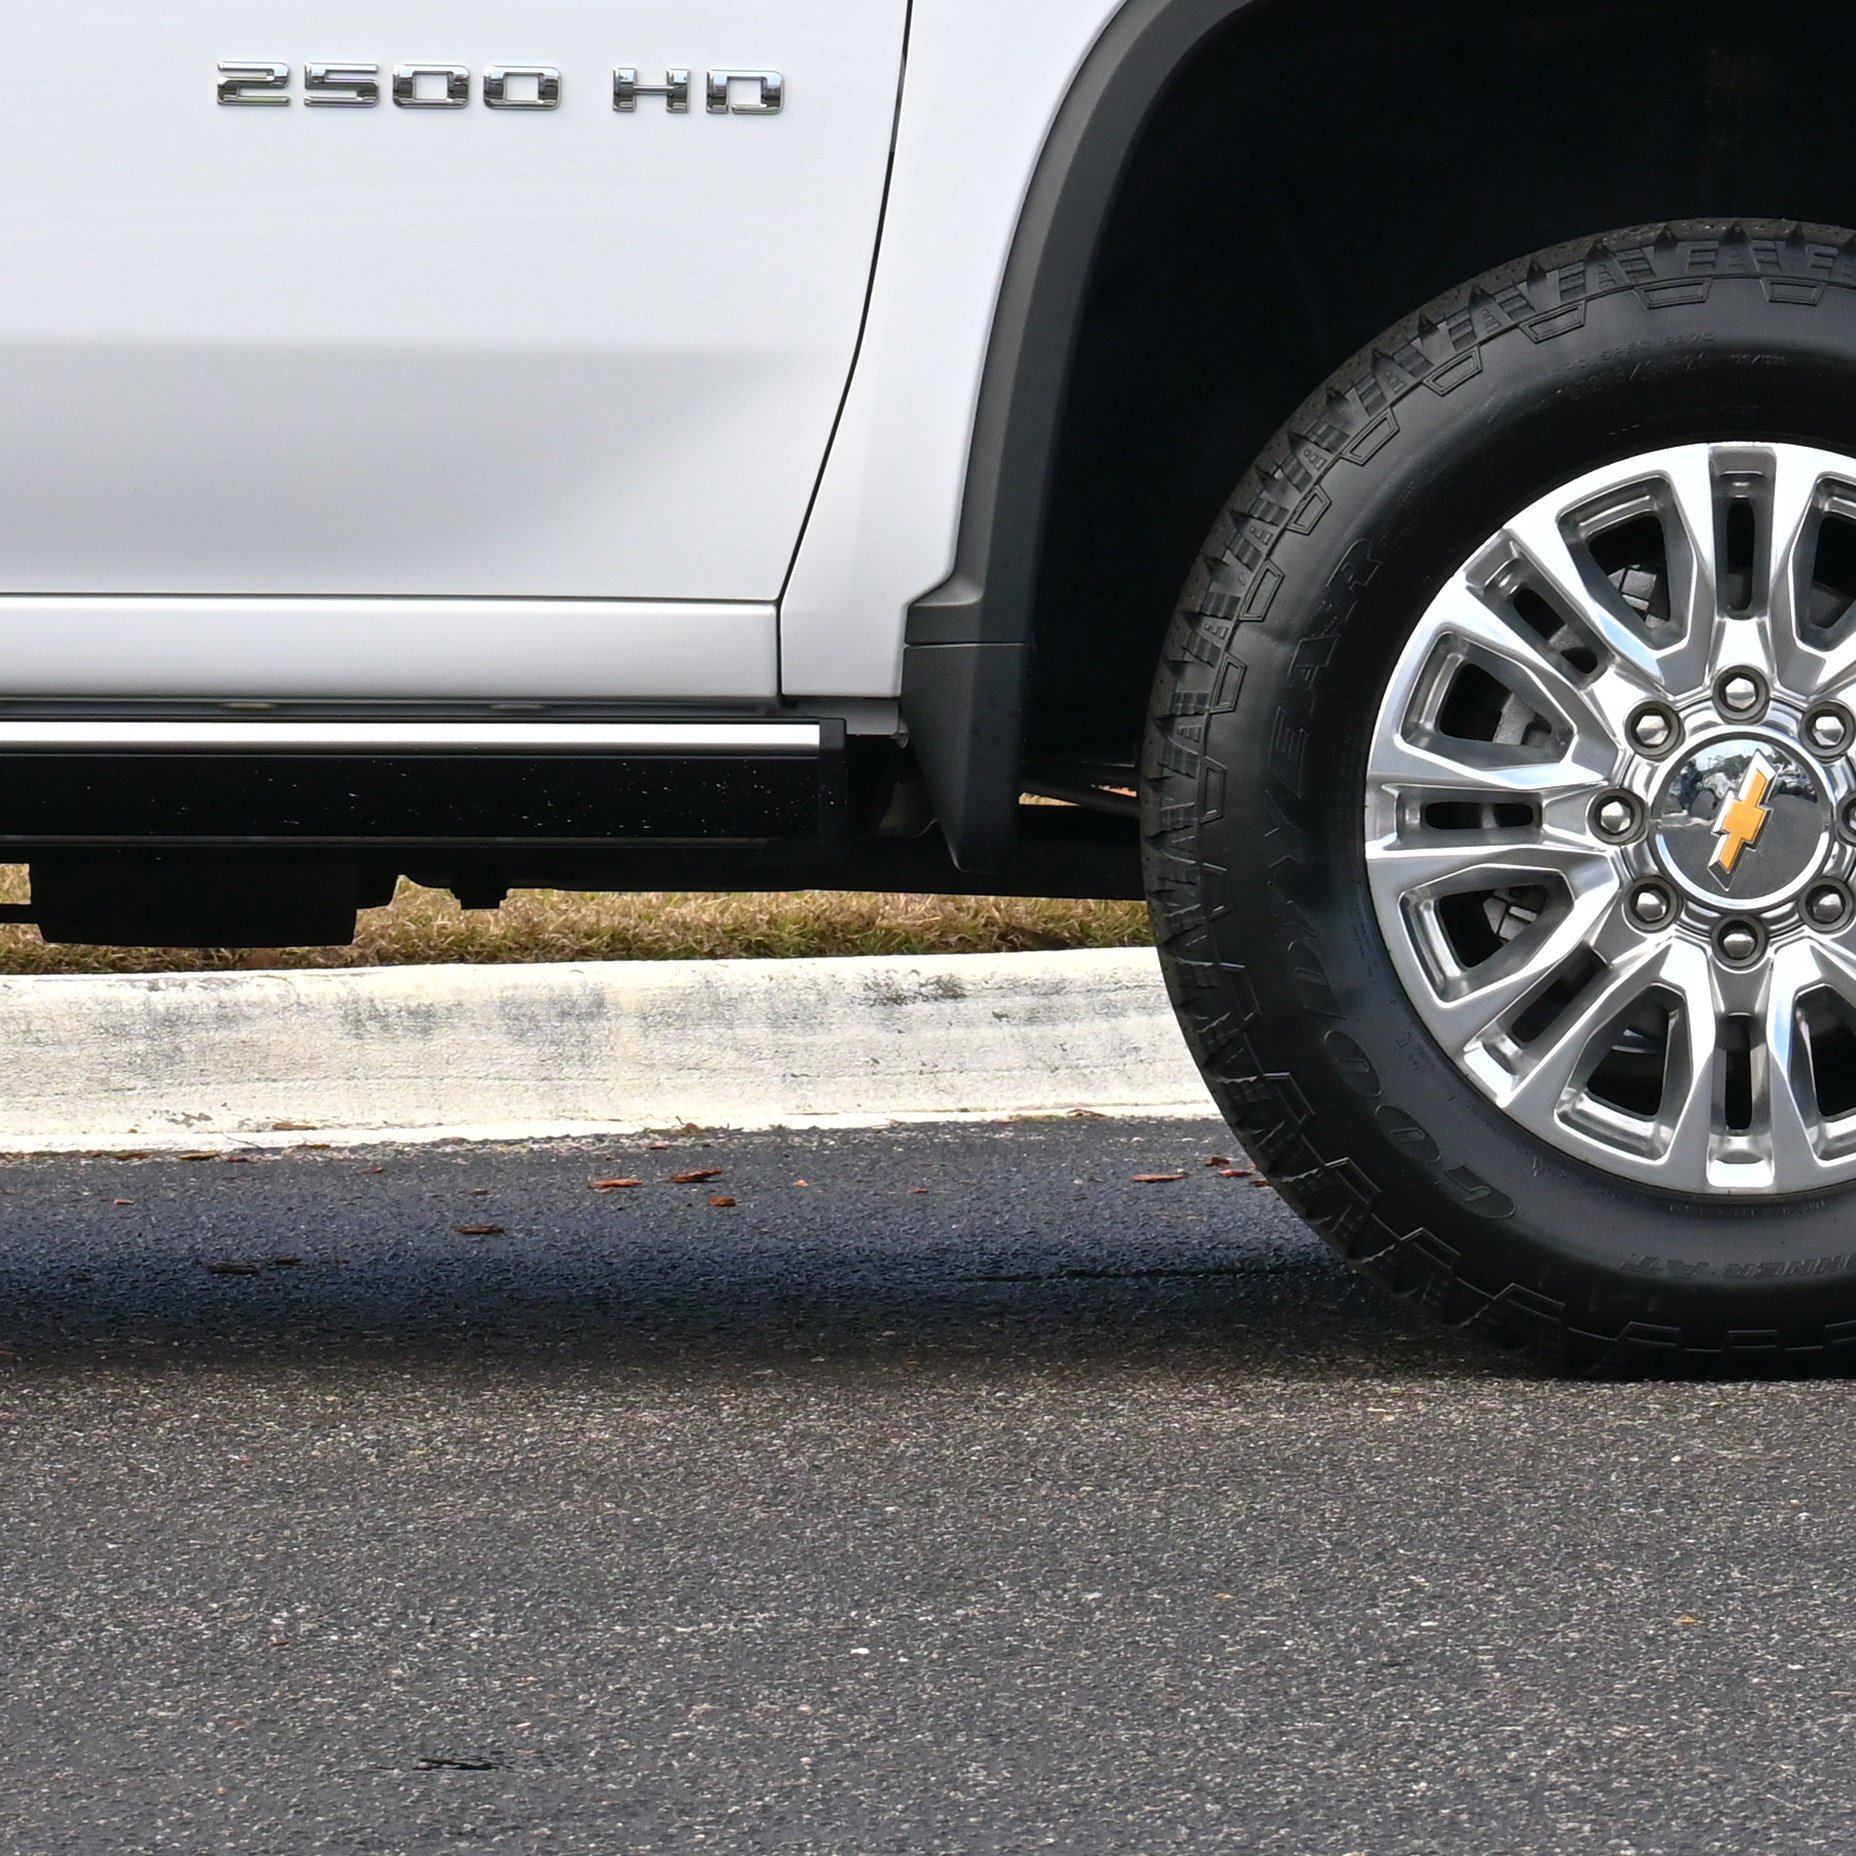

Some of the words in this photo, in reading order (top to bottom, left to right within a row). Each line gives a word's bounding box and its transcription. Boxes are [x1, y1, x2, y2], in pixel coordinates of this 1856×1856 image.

[216, 60, 562, 110] 2500
[612, 66, 785, 116] HD
[1263, 531, 1521, 1230] GOODYEAR
